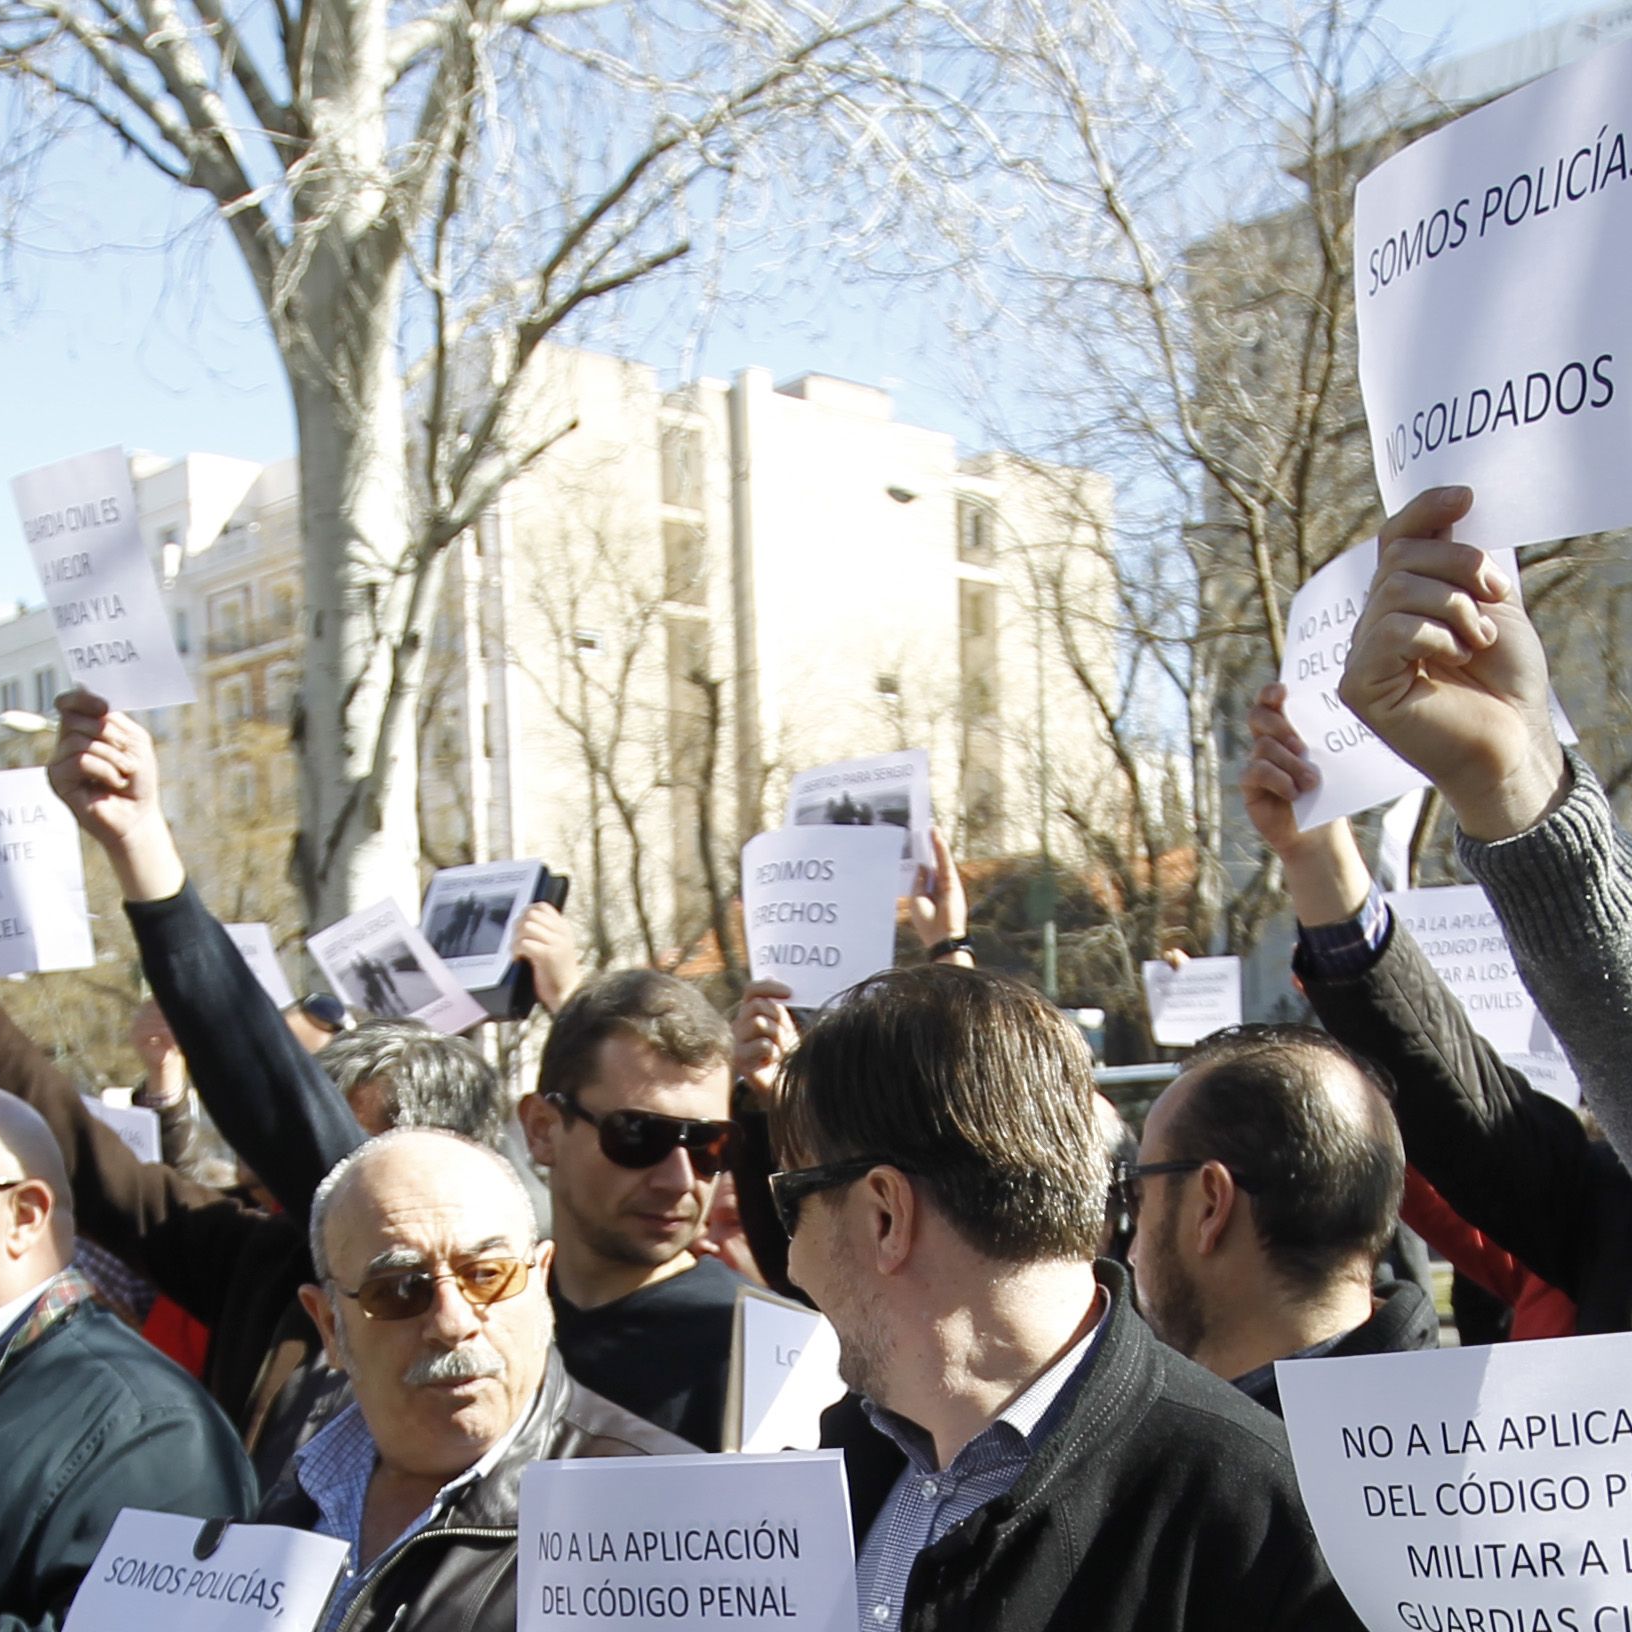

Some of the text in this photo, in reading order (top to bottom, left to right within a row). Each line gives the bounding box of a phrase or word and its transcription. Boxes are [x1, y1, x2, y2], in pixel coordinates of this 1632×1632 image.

[1369, 199, 1469, 297] SOMOS
[1385, 354, 1614, 481] NO SOLDADOS
[1298, 616, 1317, 643] NO
[1320, 609, 1332, 632] A
[1336, 598, 1358, 624] LA
[1298, 650, 1329, 681] DEL
[873, 763, 914, 781] SERGIO
[21, 804, 47, 824] LA
[1481, 963, 1509, 981] LOS
[1469, 991, 1523, 1010] CIVILES
[1342, 1425, 1393, 1458] NO
[1406, 1422, 1431, 1456] A
[1441, 1420, 1484, 1454] LA
[1363, 1483, 1426, 1517] DEL
[1435, 1473, 1590, 1515] CÓDIGO
[538, 1520, 800, 1562] NO A LA APLICACIÓN
[1406, 1541, 1565, 1579] MILITAR
[1579, 1541, 1609, 1577] A
[104, 1556, 286, 1617] SOMOS POLICÍAS,
[542, 1579, 797, 1617] DEL CÓDIGO PENAL
